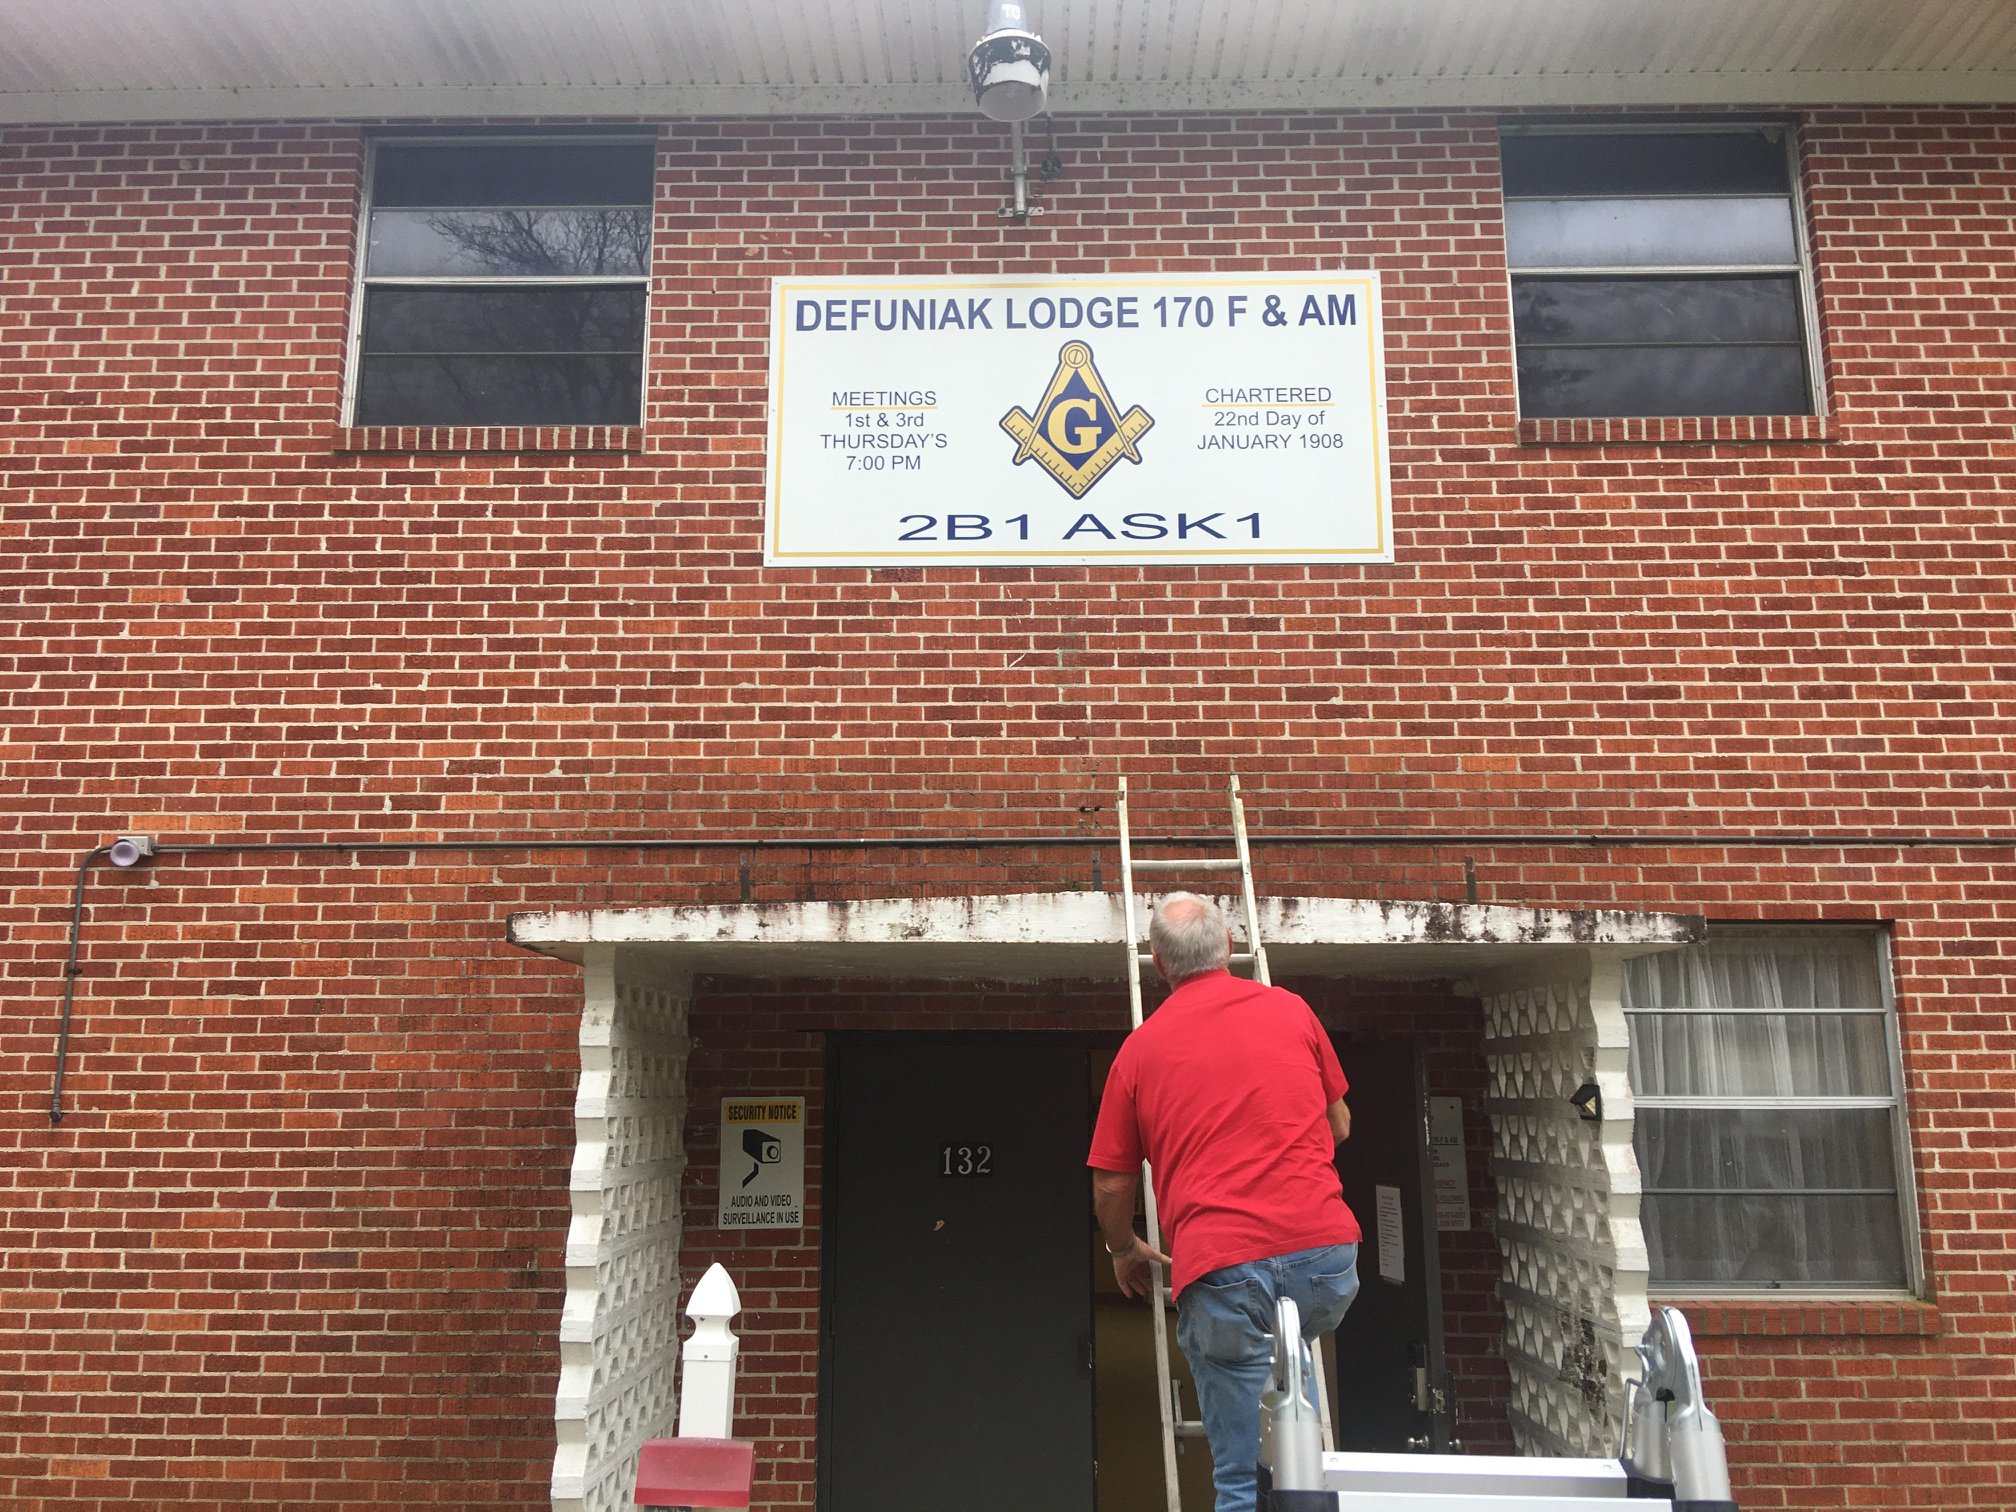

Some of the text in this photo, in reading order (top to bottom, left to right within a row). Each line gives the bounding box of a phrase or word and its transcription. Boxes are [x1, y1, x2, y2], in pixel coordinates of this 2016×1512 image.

[796, 293, 1357, 332] DEFUNIAK LODGE 170 F & AM
[832, 390, 937, 407] MEETINGS
[1205, 387, 1332, 404] CHARTERED
[845, 412, 924, 428] 1st & 3rd
[1048, 398, 1102, 454] G
[1214, 410, 1326, 430] 22nd Day of
[819, 433, 948, 449] THURSDAY'S
[1197, 433, 1344, 450] JANUARY 1908
[846, 455, 921, 471] 7:00 PM
[898, 512, 1261, 542] 2B1 ASK1
[728, 1104, 796, 1120] SECURITY NOTICE
[943, 1145, 991, 1175] 132
[731, 1194, 792, 1207] AUDIO AND VIDEO
[723, 1211, 799, 1225] SURVEILLANCE IN USE
